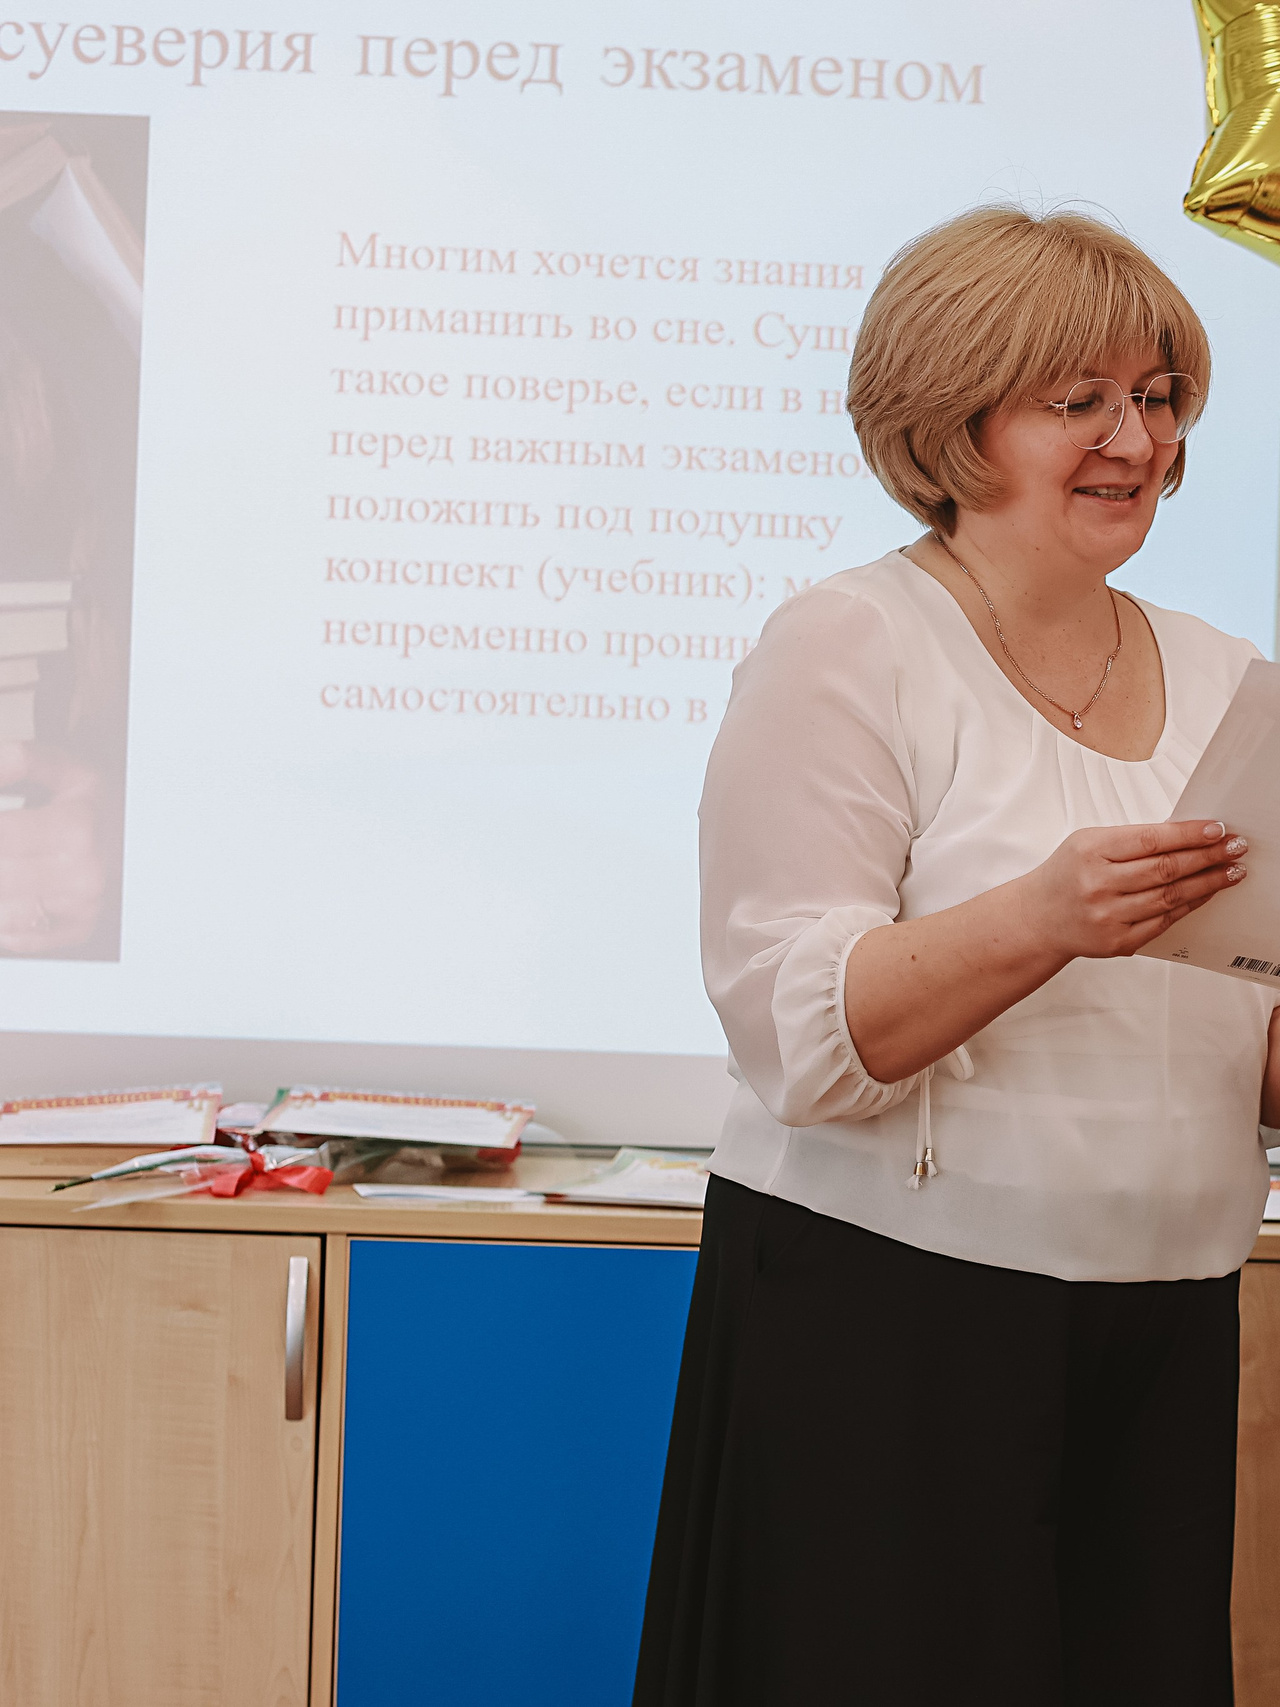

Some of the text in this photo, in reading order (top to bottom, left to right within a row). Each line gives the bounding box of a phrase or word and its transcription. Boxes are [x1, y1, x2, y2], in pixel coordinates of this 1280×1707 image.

[0, 20, 986, 105] суеверия перед экзаменом
[336, 230, 866, 291] Многим хочется знания
[334, 303, 856, 361] приманить во сне. Сущ
[331, 367, 450, 398] такое
[464, 372, 651, 415] поверье,
[665, 381, 766, 413] если
[780, 386, 804, 415] в
[329, 429, 870, 480] перед важным экзамено
[327, 493, 844, 553] положить под подушку
[324, 556, 523, 591] конспект
[537, 557, 767, 606] (учебник):
[322, 618, 758, 667] непременно проник
[319, 682, 709, 725] самостоятельно в
